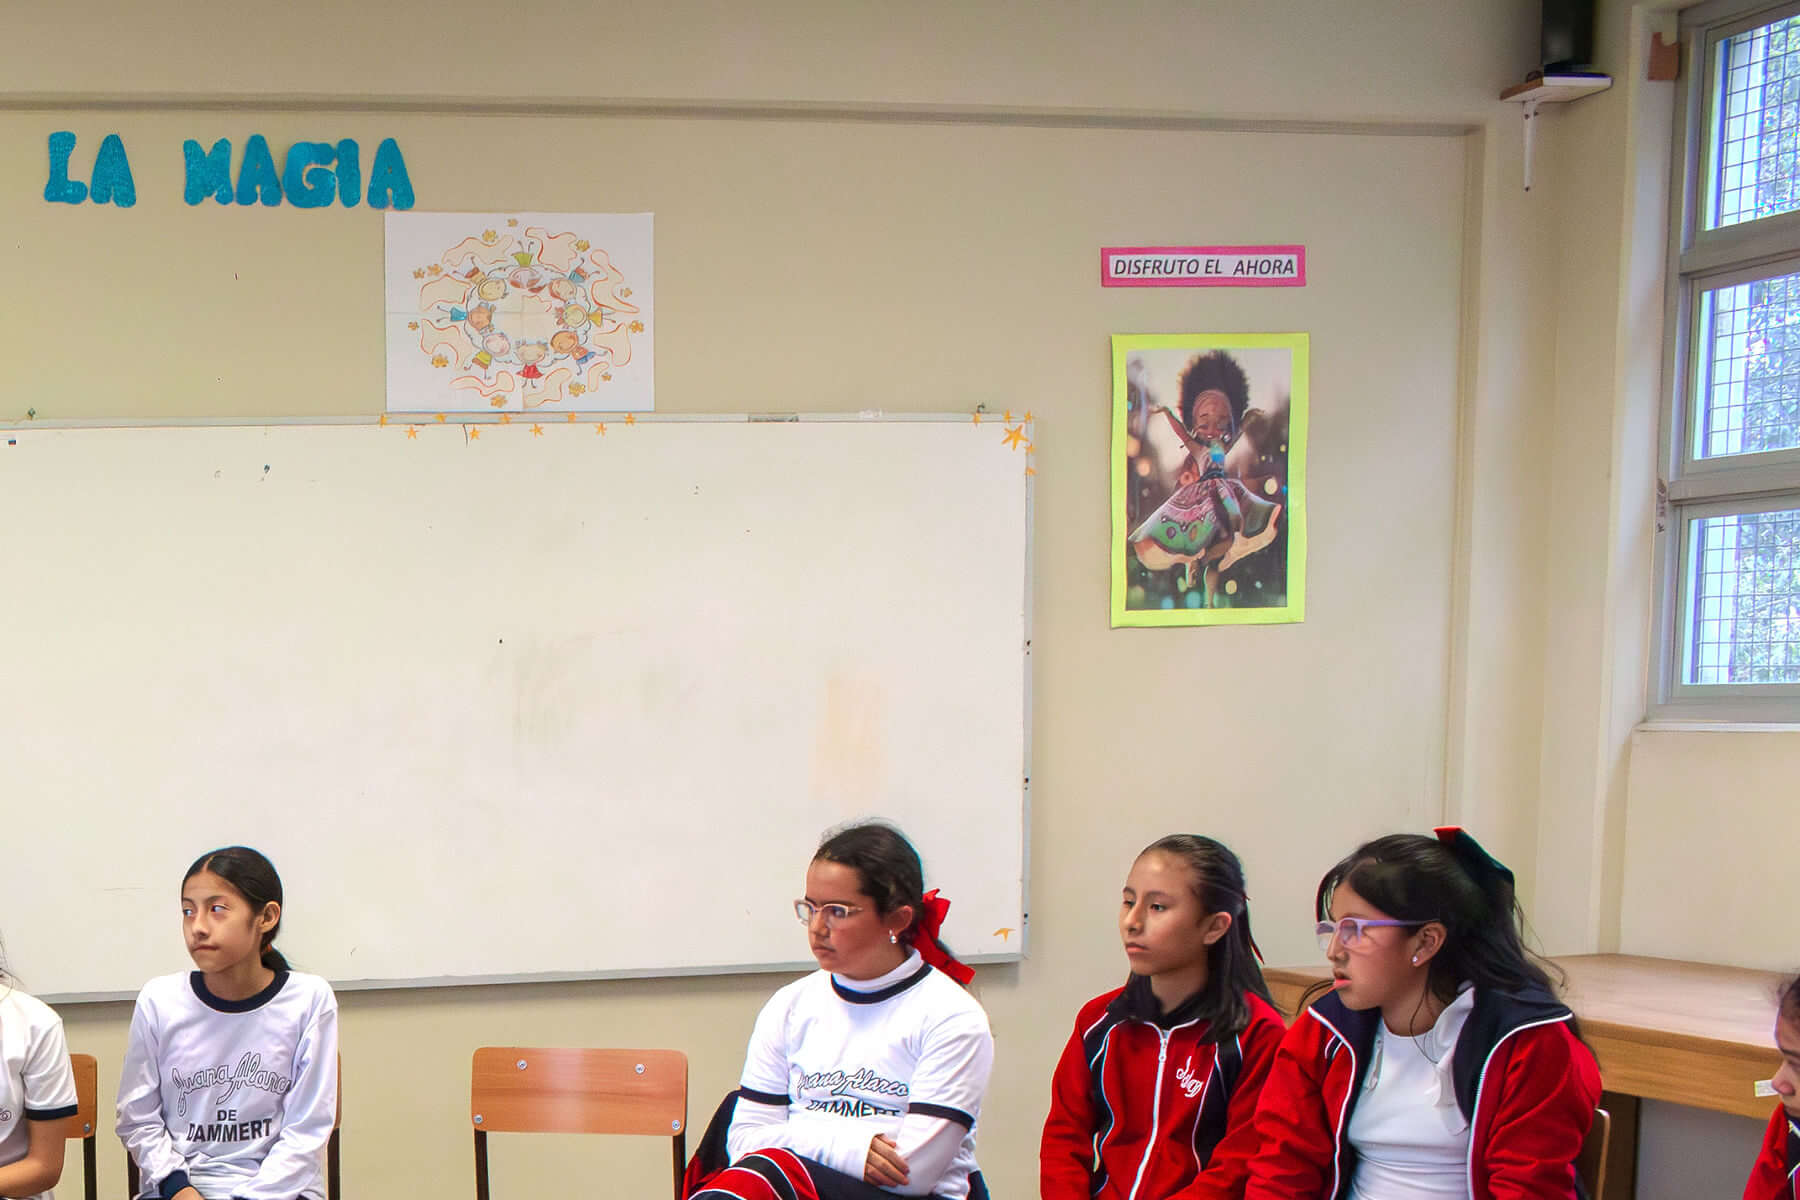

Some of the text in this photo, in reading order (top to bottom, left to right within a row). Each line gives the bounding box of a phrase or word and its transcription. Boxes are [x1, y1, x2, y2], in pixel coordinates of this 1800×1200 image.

[44, 131, 415, 210] LA MAGIA
[1114, 259, 1295, 276] DISFRUTO EL AHORA
[172, 1051, 291, 1117] Juana Alarc
[216, 1109, 237, 1121] DE
